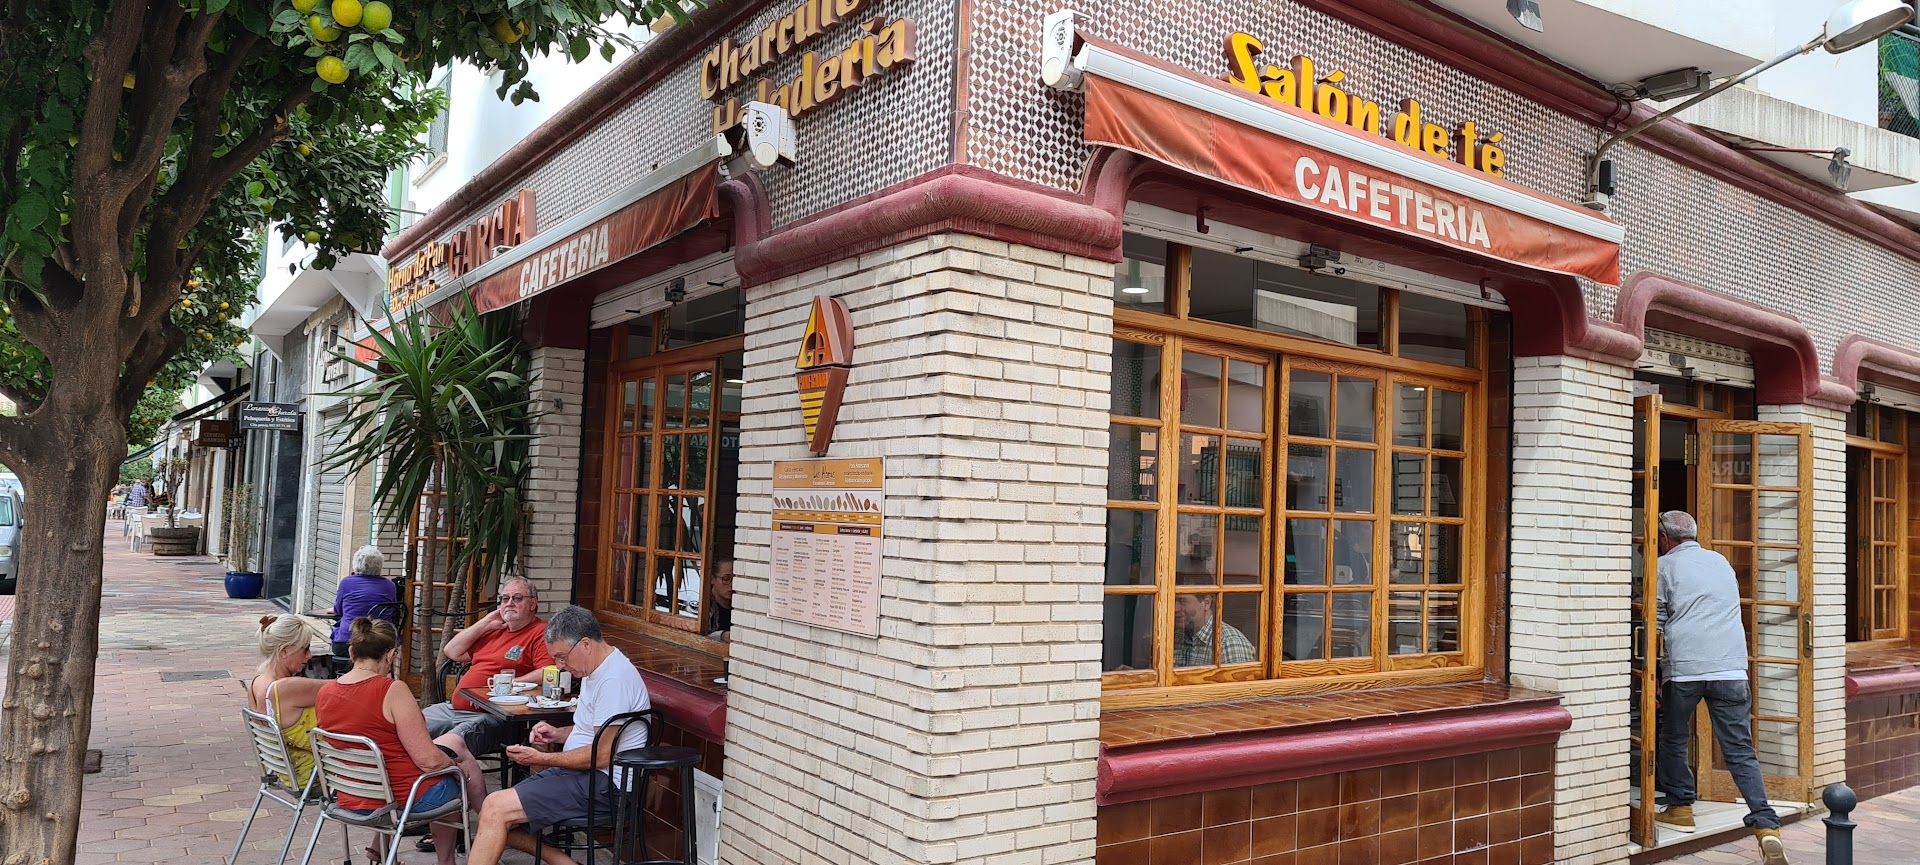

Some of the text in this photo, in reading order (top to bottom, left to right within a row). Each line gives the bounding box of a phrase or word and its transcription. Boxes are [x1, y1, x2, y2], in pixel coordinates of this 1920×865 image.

[1224, 31, 1505, 178] Salón de té
[1294, 156, 1492, 249] CAFETERIA
[388, 241, 447, 295] Horno de Pan
[519, 223, 609, 298] CAFETERIA
